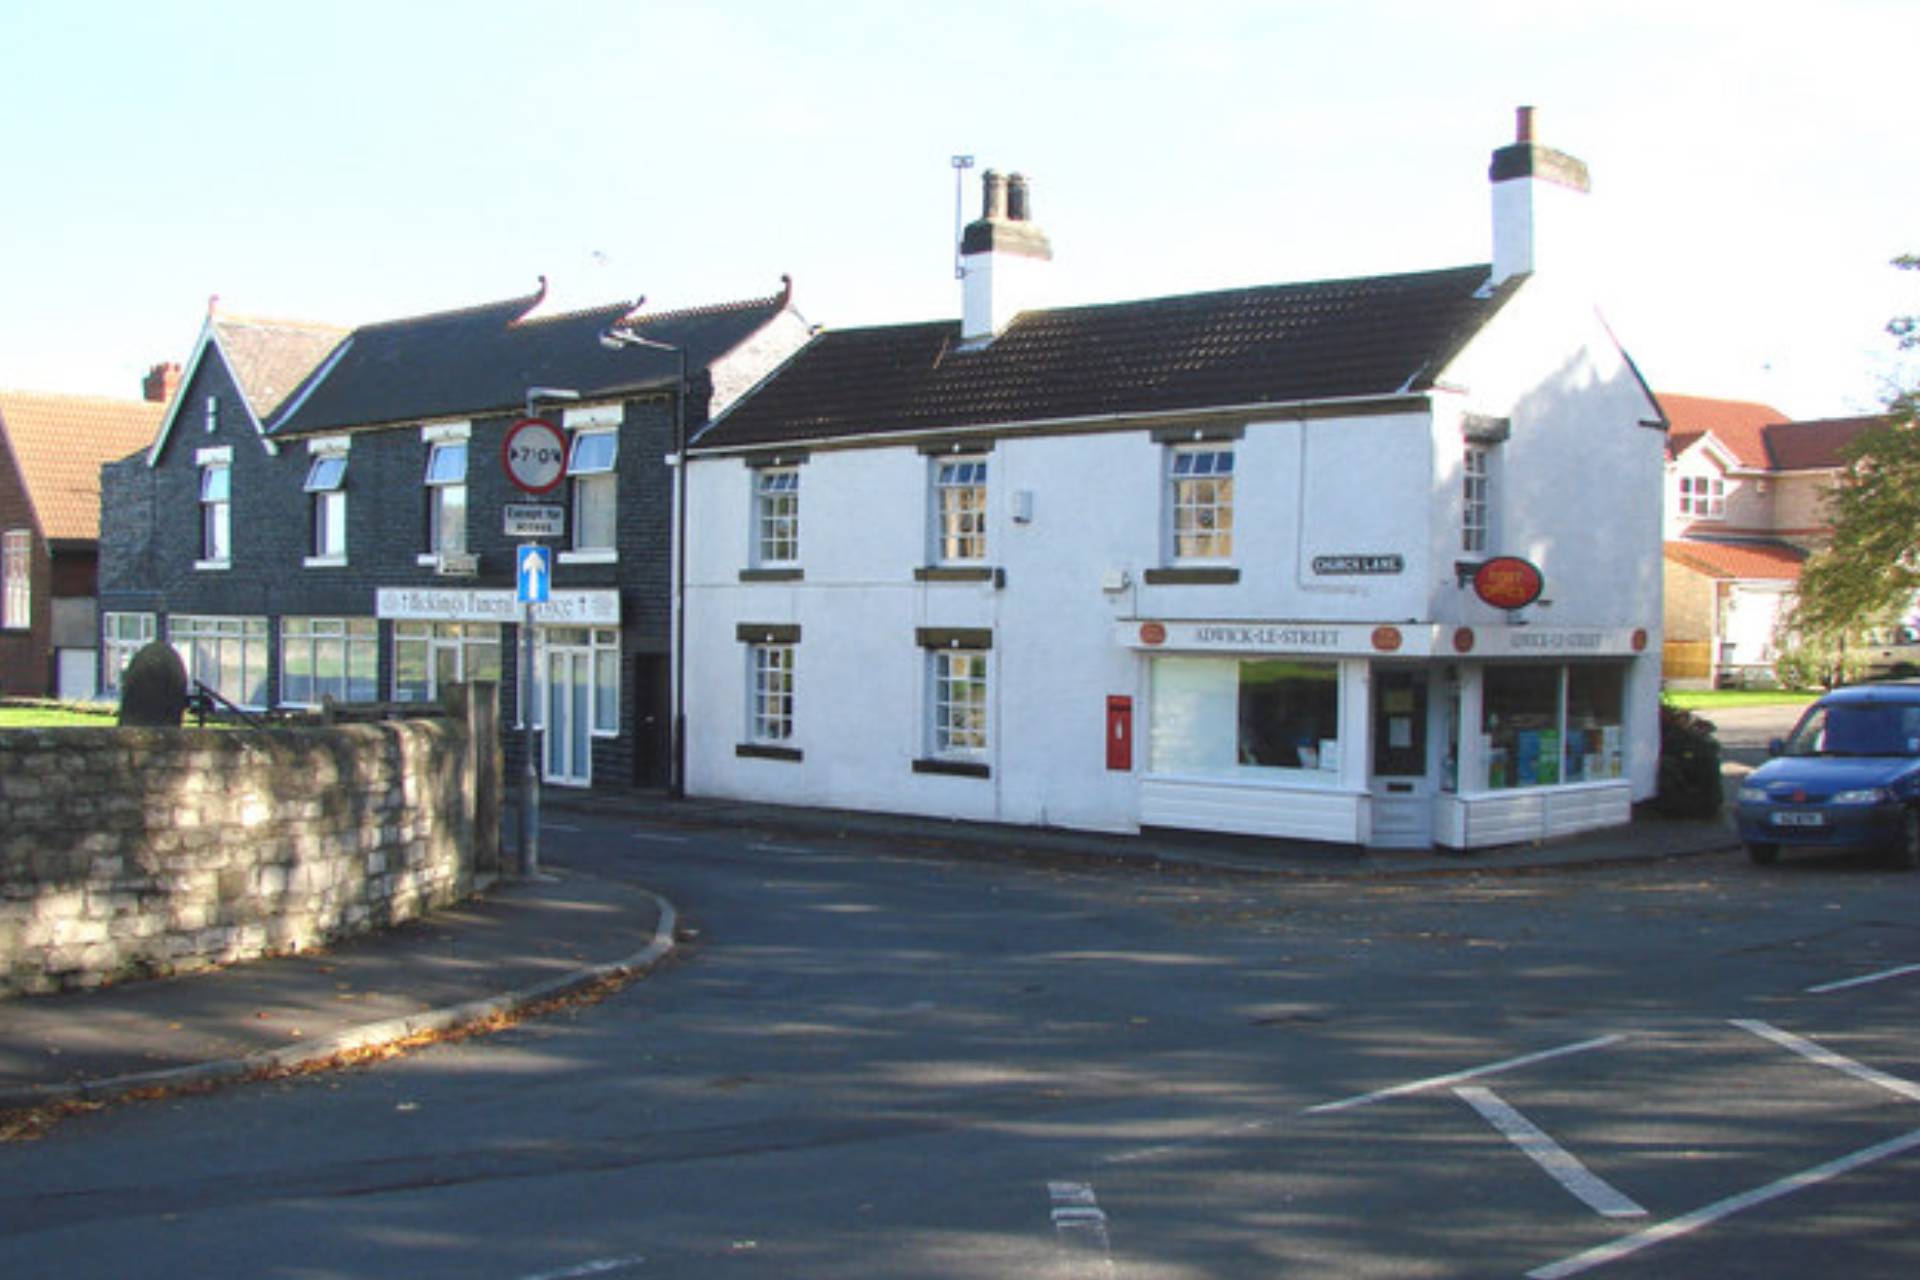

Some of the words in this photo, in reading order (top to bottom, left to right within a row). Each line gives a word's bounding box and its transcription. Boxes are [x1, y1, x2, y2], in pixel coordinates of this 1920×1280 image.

[1314, 557, 1360, 572] CHURCH
[1363, 557, 1397, 572] LANE
[1487, 570, 1524, 584] POST
